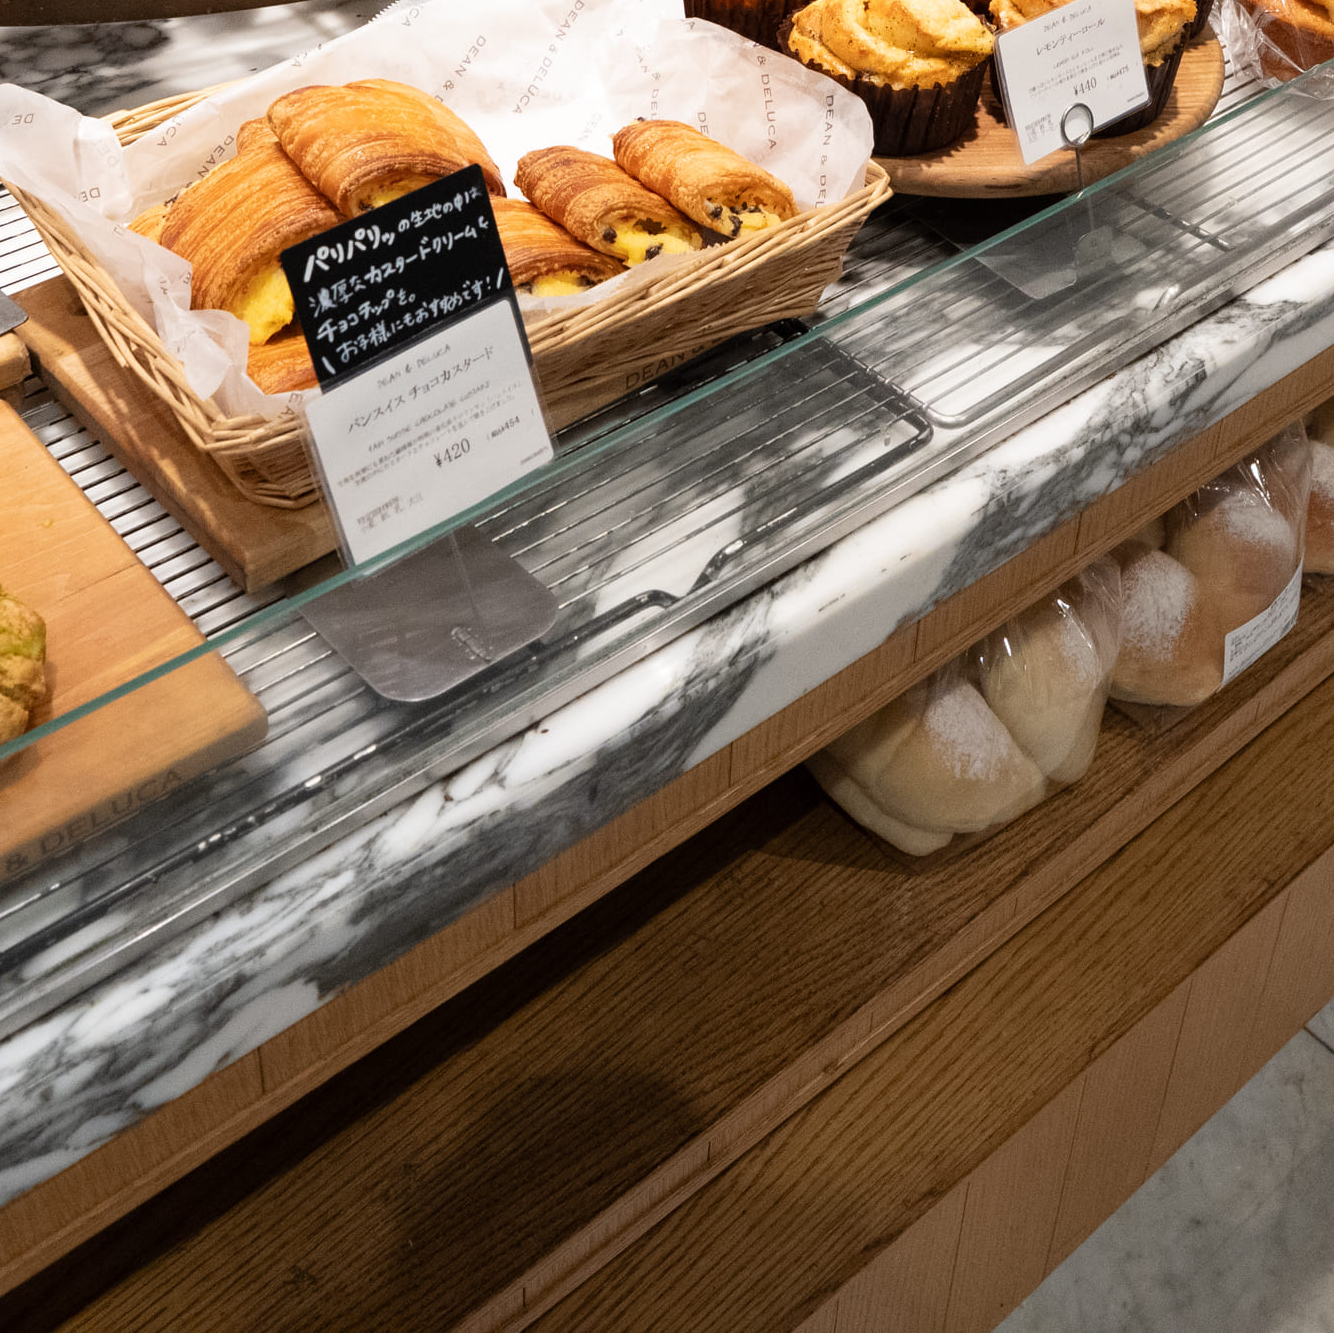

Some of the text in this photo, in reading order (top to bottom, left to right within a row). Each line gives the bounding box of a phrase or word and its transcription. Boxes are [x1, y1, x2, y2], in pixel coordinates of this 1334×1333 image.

[442, 35, 487, 91] DEAN &
[511, 0, 585, 114] DEAN & DELUCA
[760, 73, 778, 150] DELUCA
[1073, 77, 1097, 96] ¥440
[821, 94, 835, 146] DEAN
[821, 155, 828, 166] &
[308, 216, 490, 318] 濃厚なカスタードクリームと
[316, 288, 417, 343] チョコチップを。
[349, 346, 495, 434] パンスイス チョコカスタード
[625, 352, 685, 390] DEAN
[434, 438, 471, 468] ¥420
[3, 852, 29, 872] &
[39, 769, 184, 856] DELUCA
